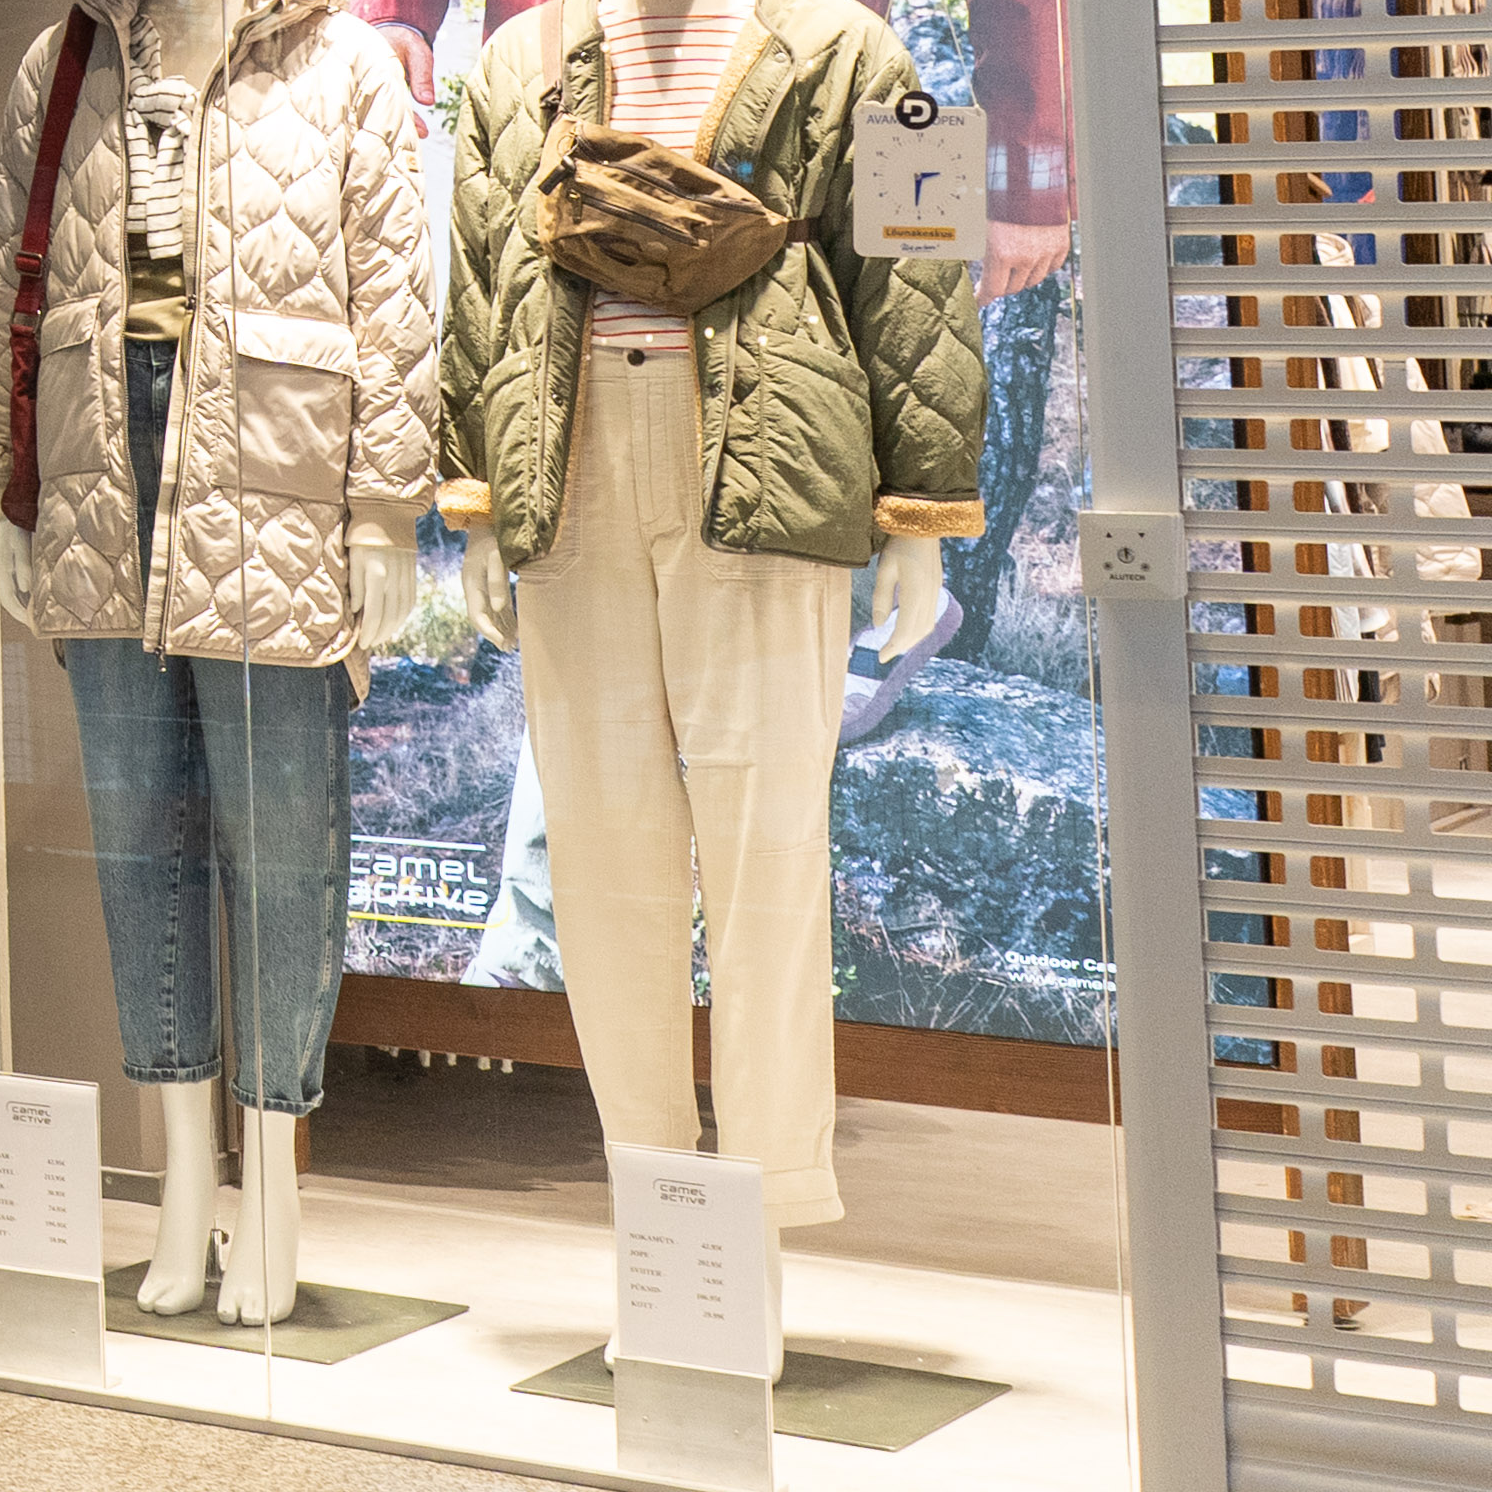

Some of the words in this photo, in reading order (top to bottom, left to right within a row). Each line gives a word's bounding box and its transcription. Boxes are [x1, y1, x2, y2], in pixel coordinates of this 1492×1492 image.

[350, 851, 488, 885] camel
[1004, 950, 1080, 970] Outdoor
[12, 1106, 52, 1117] camel
[660, 1184, 707, 1198] camel
[660, 1193, 707, 1206] active
